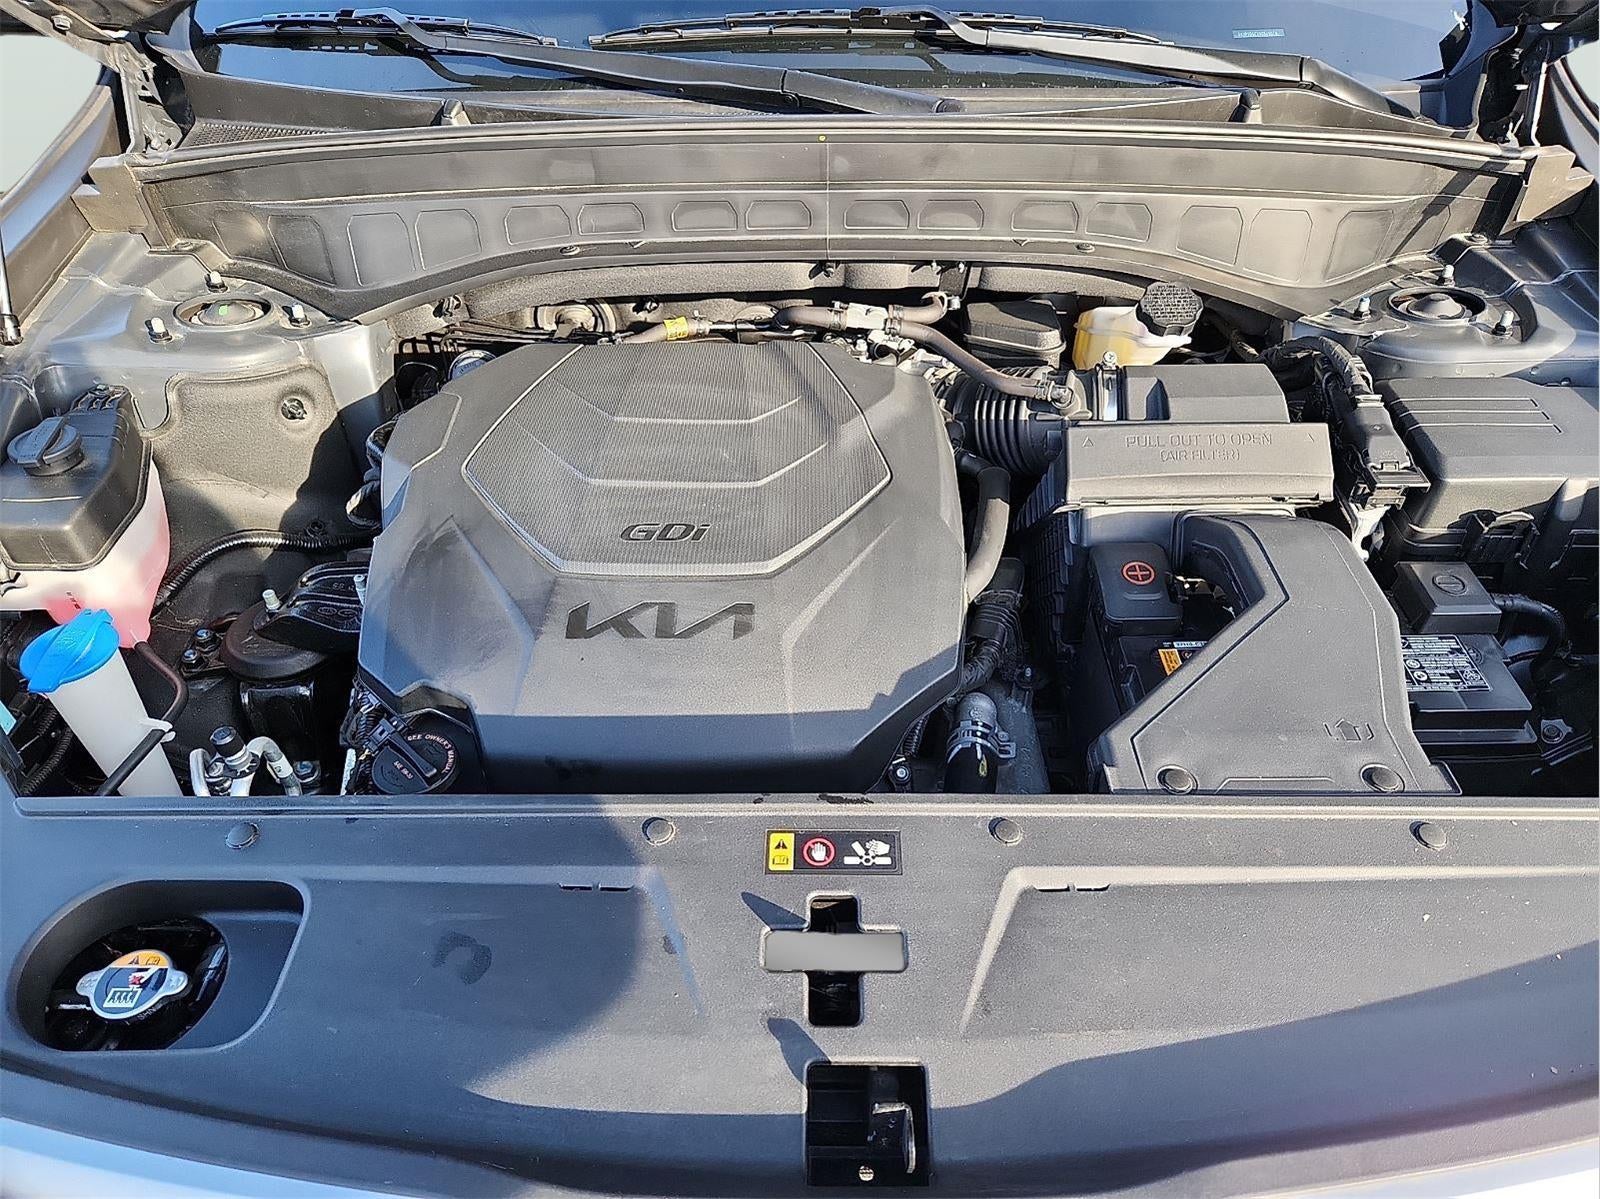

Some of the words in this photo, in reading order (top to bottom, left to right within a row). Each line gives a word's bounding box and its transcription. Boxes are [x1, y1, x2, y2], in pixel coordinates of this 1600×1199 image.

[1125, 434, 1165, 448] PULL
[1169, 433, 1200, 447] OUT
[1207, 433, 1226, 446] TO
[1229, 432, 1273, 446] OPEN
[1160, 449, 1188, 462] (AIR
[1191, 448, 1241, 461] FILTER)
[620, 523, 711, 542] GDi
[565, 600, 755, 640] KIA
